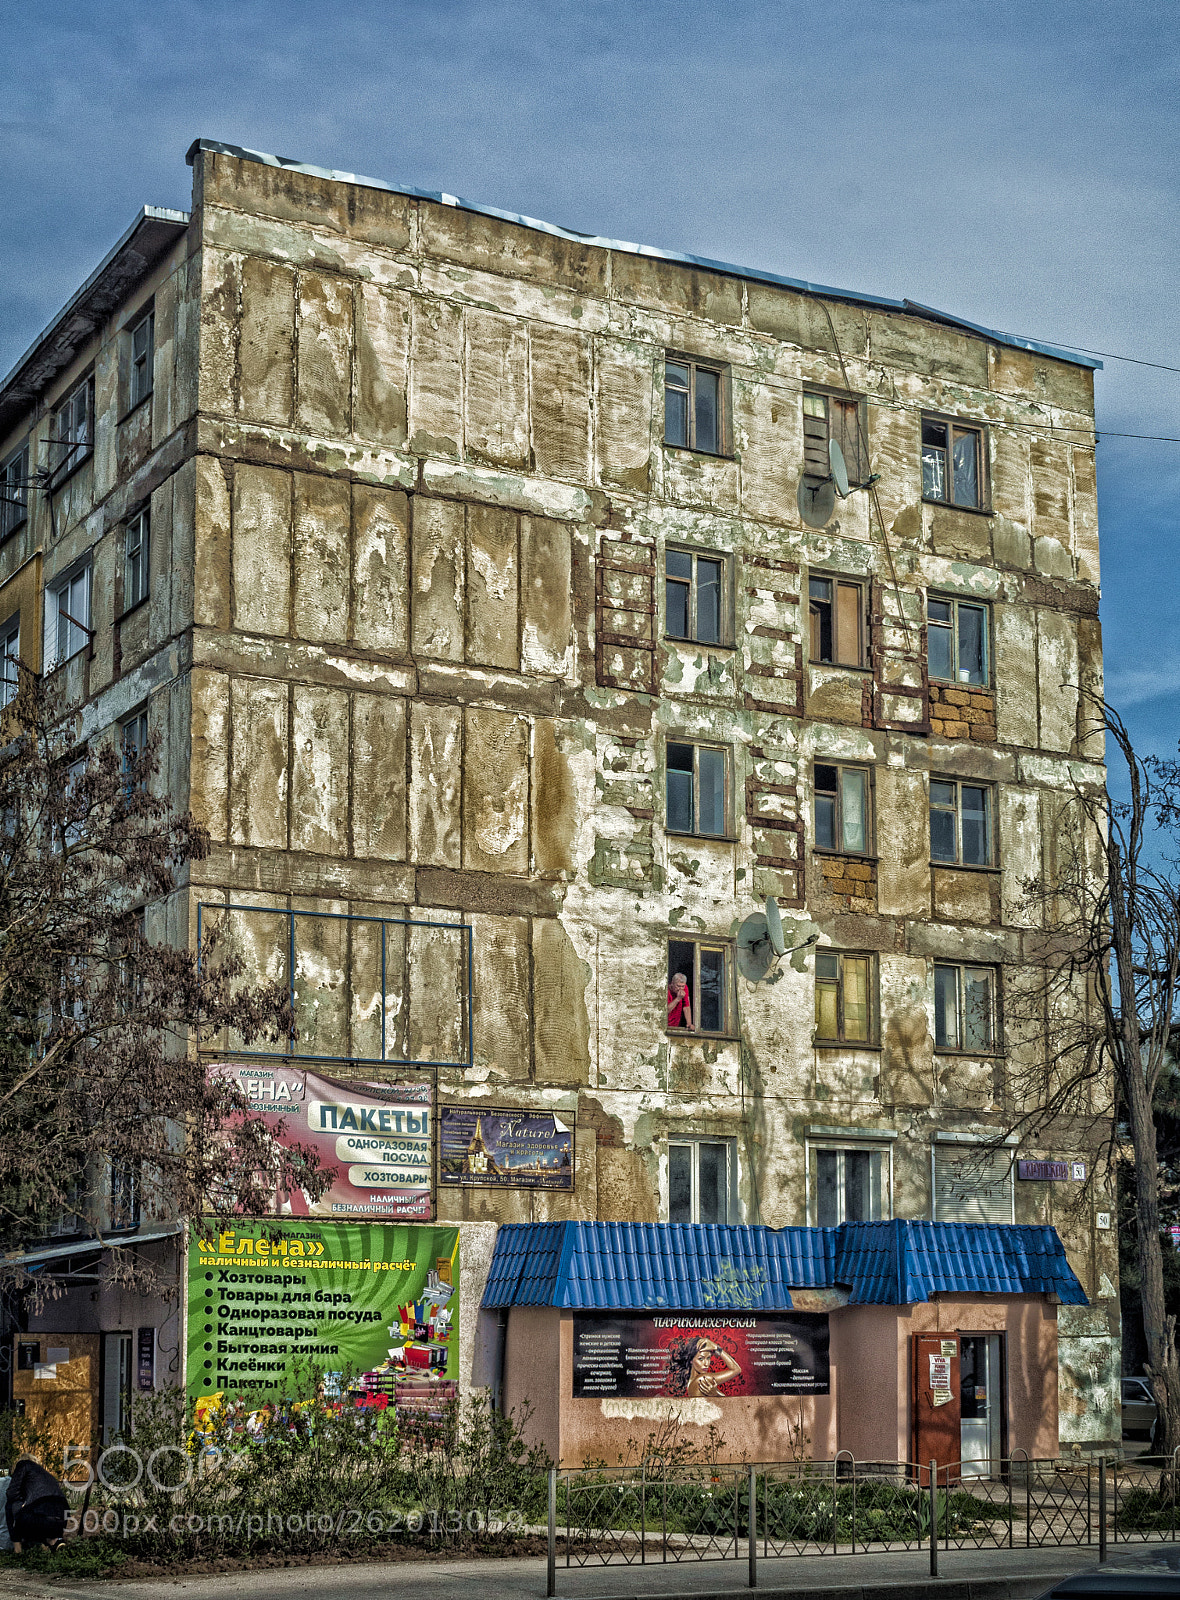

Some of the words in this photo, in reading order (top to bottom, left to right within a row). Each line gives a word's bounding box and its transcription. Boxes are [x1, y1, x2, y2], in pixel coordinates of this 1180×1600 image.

[240, 1070, 274, 1079] МАГАЗИН
[320, 1105, 428, 1135] ПАКЕТЫ
[500, 1118, 557, 1139] Naturel
[347, 1138, 427, 1152] ОДНОРАЗОВАЯ
[496, 1140, 525, 1149] Магазин
[382, 1153, 427, 1164] ПОСУДА
[364, 1171, 428, 1184] ХОЗТОВАРЫ
[370, 1194, 417, 1204] НАЛИЧНЫЙ
[332, 1203, 394, 1214] БЕЗНАЛИЧНЫЙ
[396, 1206, 426, 1214] РАСЧЕТ
[1099, 1216, 1108, 1226] 50
[197, 1230, 325, 1257] «Елена»
[199, 1256, 269, 1267] наличный
[271, 1258, 280, 1267] и
[282, 1256, 371, 1271] безналичный
[373, 1259, 417, 1273] расчёт
[217, 1269, 307, 1287] Хозтовары
[217, 1287, 278, 1305] Товары
[281, 1292, 311, 1303] для
[314, 1289, 352, 1306] бара
[217, 1305, 325, 1321] Одноразовая
[328, 1310, 382, 1324] посуда
[653, 1317, 757, 1329] ПАРИКМАХЕРСКАЯ
[217, 1322, 318, 1340] Канцтовары
[216, 1340, 287, 1354] Бытовая
[290, 1343, 339, 1355] химия
[216, 1357, 286, 1372] Клеёнки
[216, 1375, 279, 1389] Пакеты
